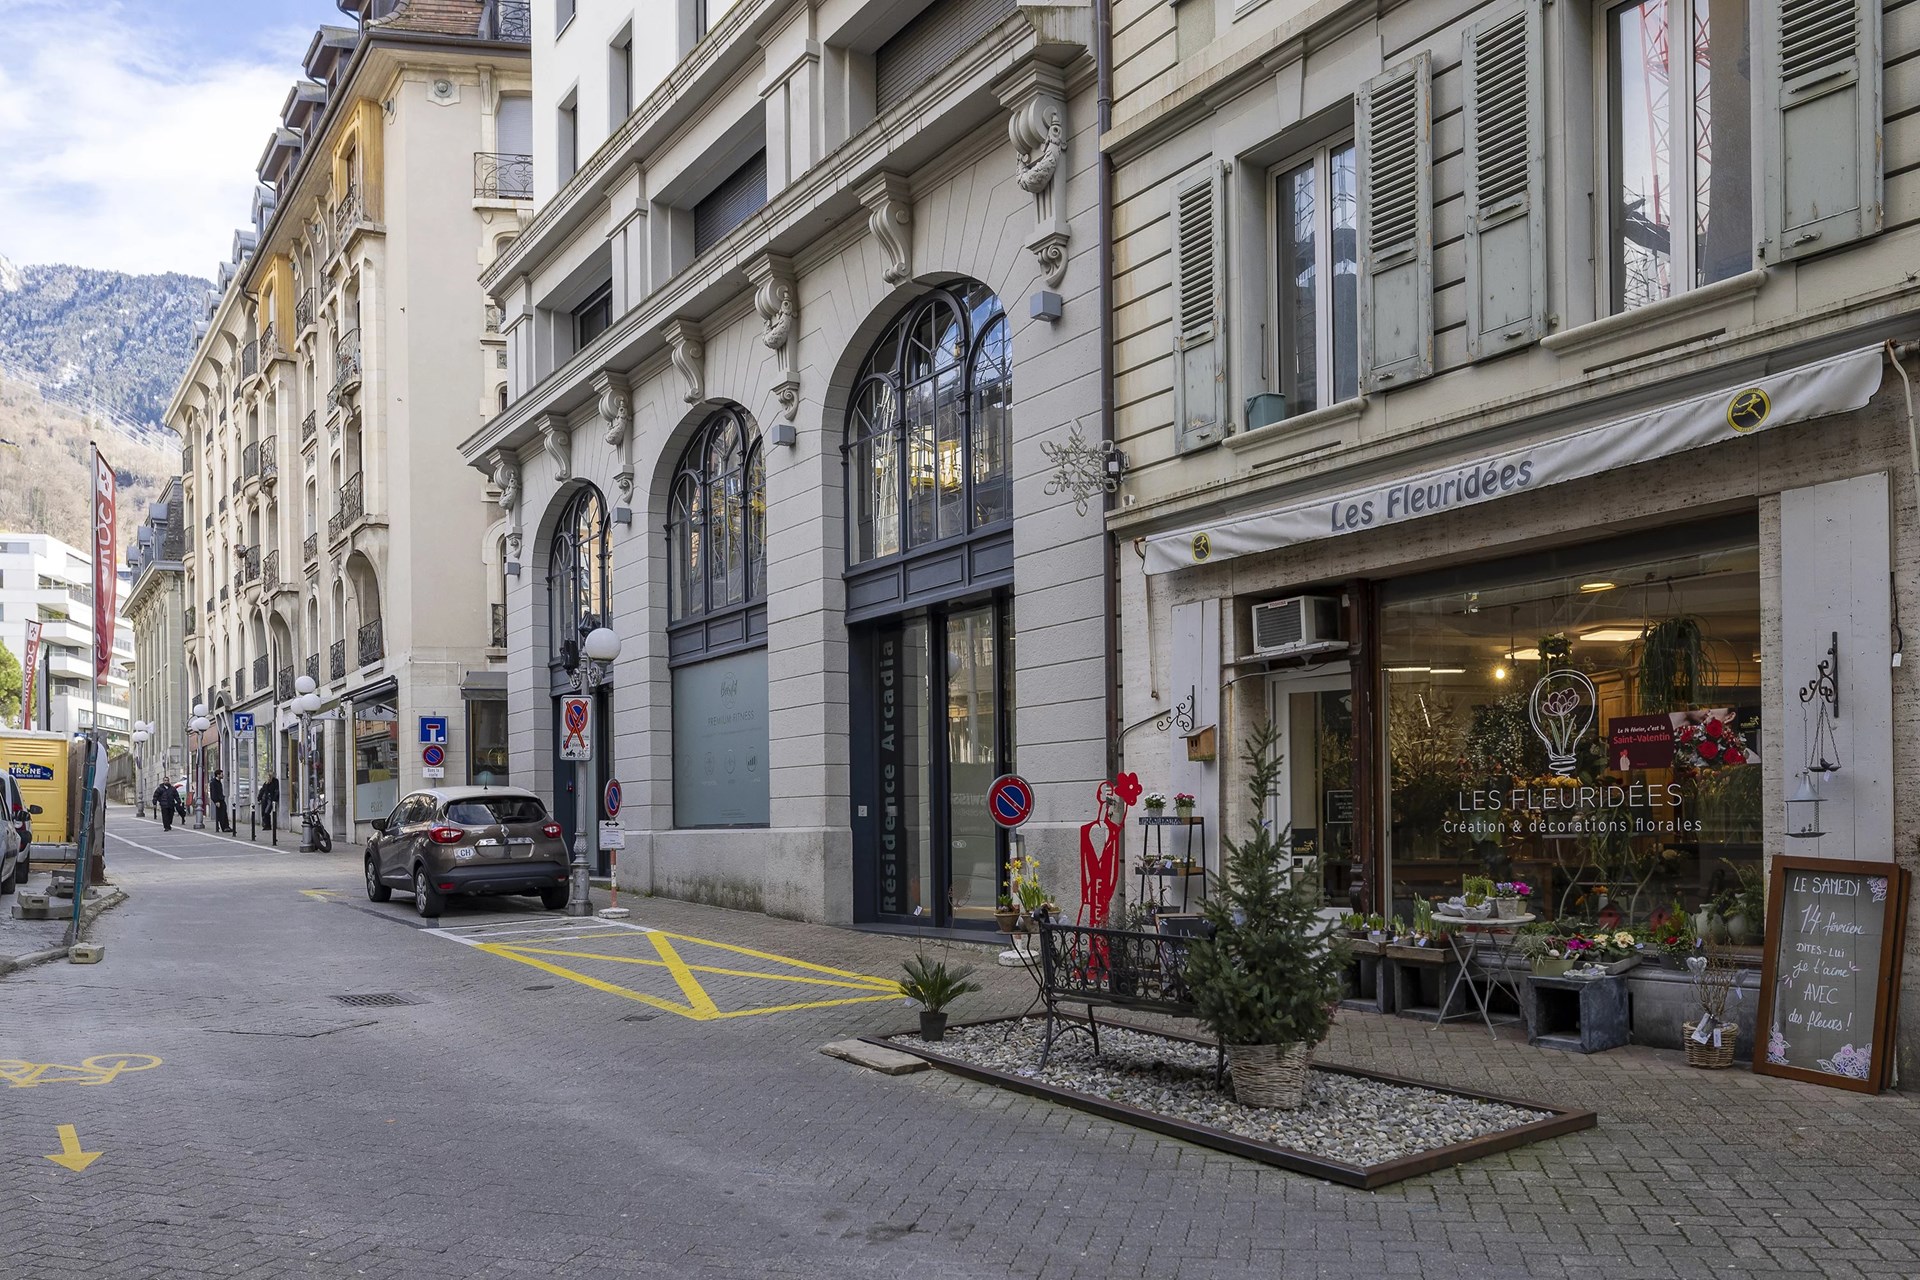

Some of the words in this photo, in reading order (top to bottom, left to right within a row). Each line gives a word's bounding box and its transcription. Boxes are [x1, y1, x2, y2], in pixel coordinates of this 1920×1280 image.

[1331, 501, 1374, 532] Les
[1387, 460, 1534, 519] Fleuridées
[880, 641, 894, 752] Arcadia
[1613, 733, 1671, 745] Saint-Valentin
[1460, 790, 1501, 811] LES
[1512, 780, 1682, 810] FLEURIDÉES
[1443, 820, 1505, 833] Création
[1512, 820, 1521, 833] &
[1529, 818, 1626, 833] décorations
[1636, 817, 1702, 832] florales
[882, 764, 897, 911] Résidence
[460, 849, 471, 857] CH
[1793, 876, 1807, 892] LE
[1801, 904, 1821, 935] 14
[1792, 960, 1809, 978] je
[1803, 982, 1839, 1005] AVEC
[1788, 1008, 1802, 1024] des
